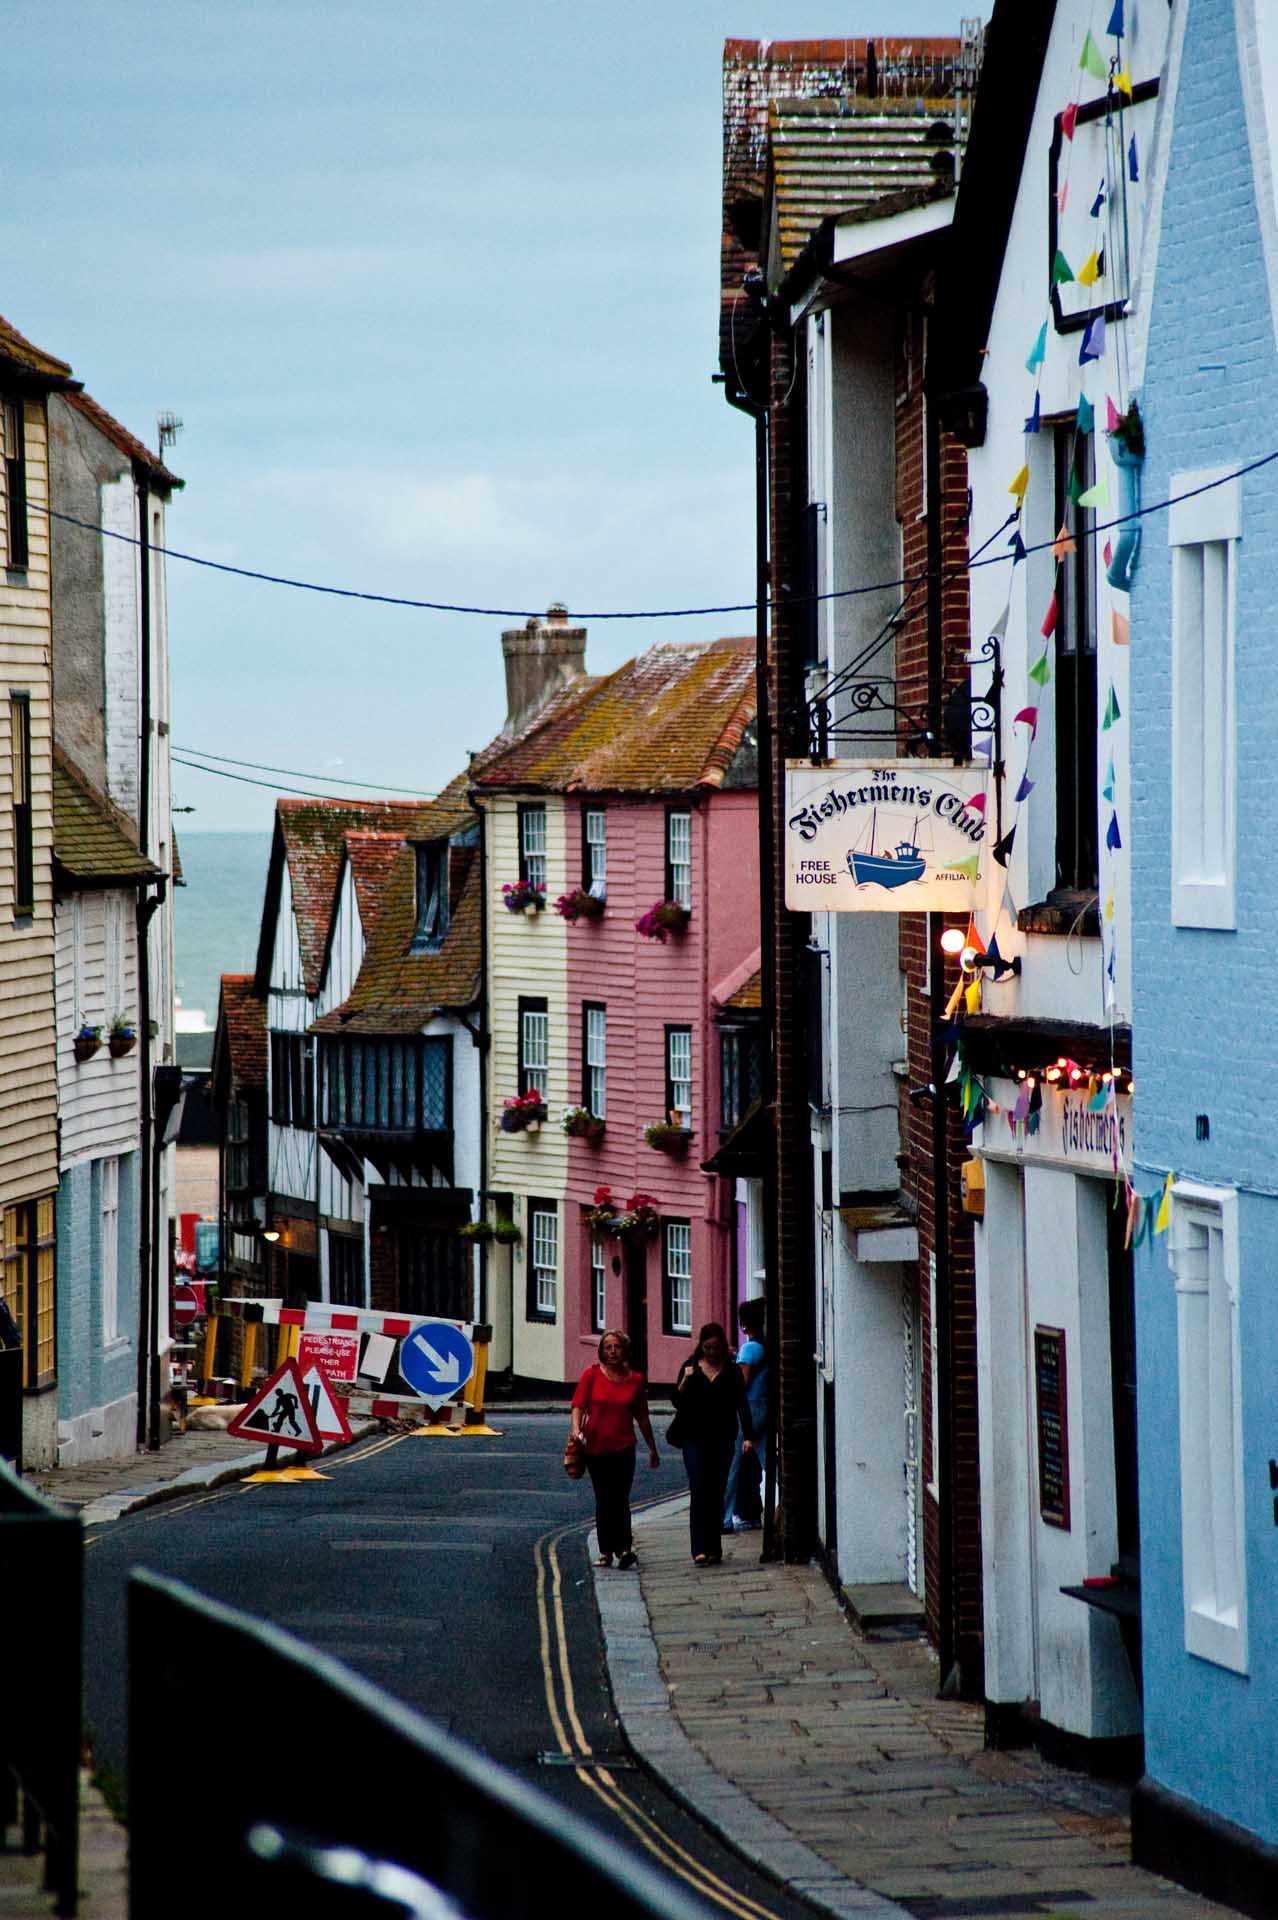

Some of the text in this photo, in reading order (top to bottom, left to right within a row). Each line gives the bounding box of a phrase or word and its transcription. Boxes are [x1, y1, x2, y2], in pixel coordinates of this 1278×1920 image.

[871, 769, 897, 781] The
[789, 785, 987, 842] Fishermen's Club
[800, 860, 831, 871] FREE
[796, 873, 838, 884] HOUSE
[935, 873, 983, 881] AFFILIAD
[319, 1358, 340, 1366] THER
